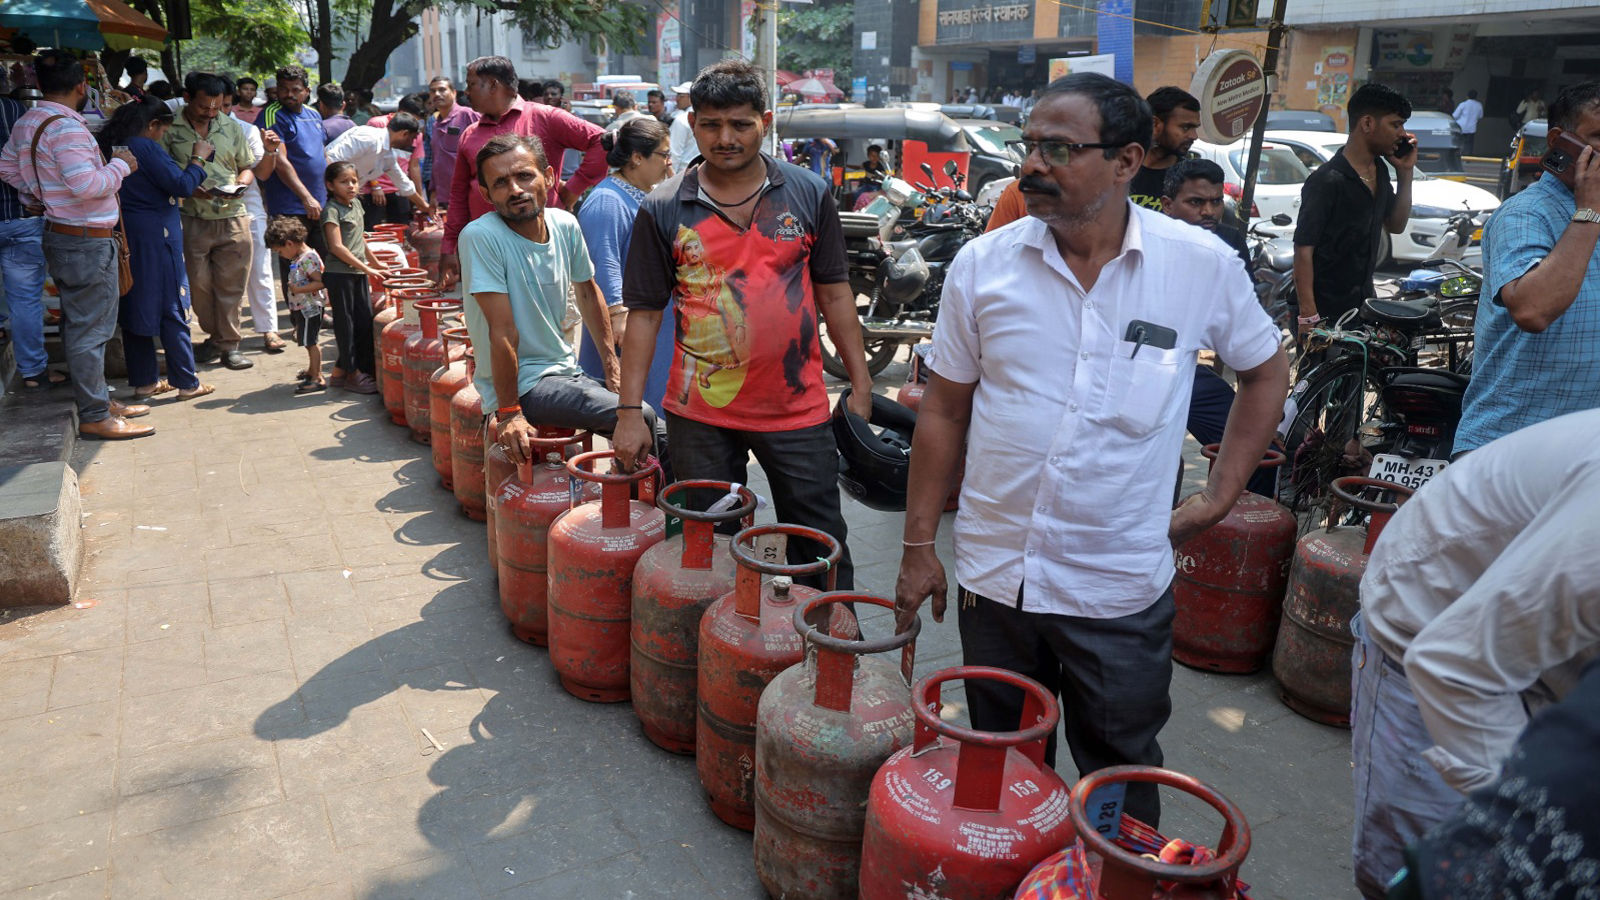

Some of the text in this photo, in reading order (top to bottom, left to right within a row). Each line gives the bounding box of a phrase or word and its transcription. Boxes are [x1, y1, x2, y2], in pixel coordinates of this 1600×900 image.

[993, 4, 1029, 22] स्थानक
[1384, 461, 1434, 478] MH.43
[922, 768, 952, 790] 15.9
[1009, 780, 1040, 798] 15.9
[1099, 802, 1117, 820] 28
[979, 850, 994, 859] NOT
